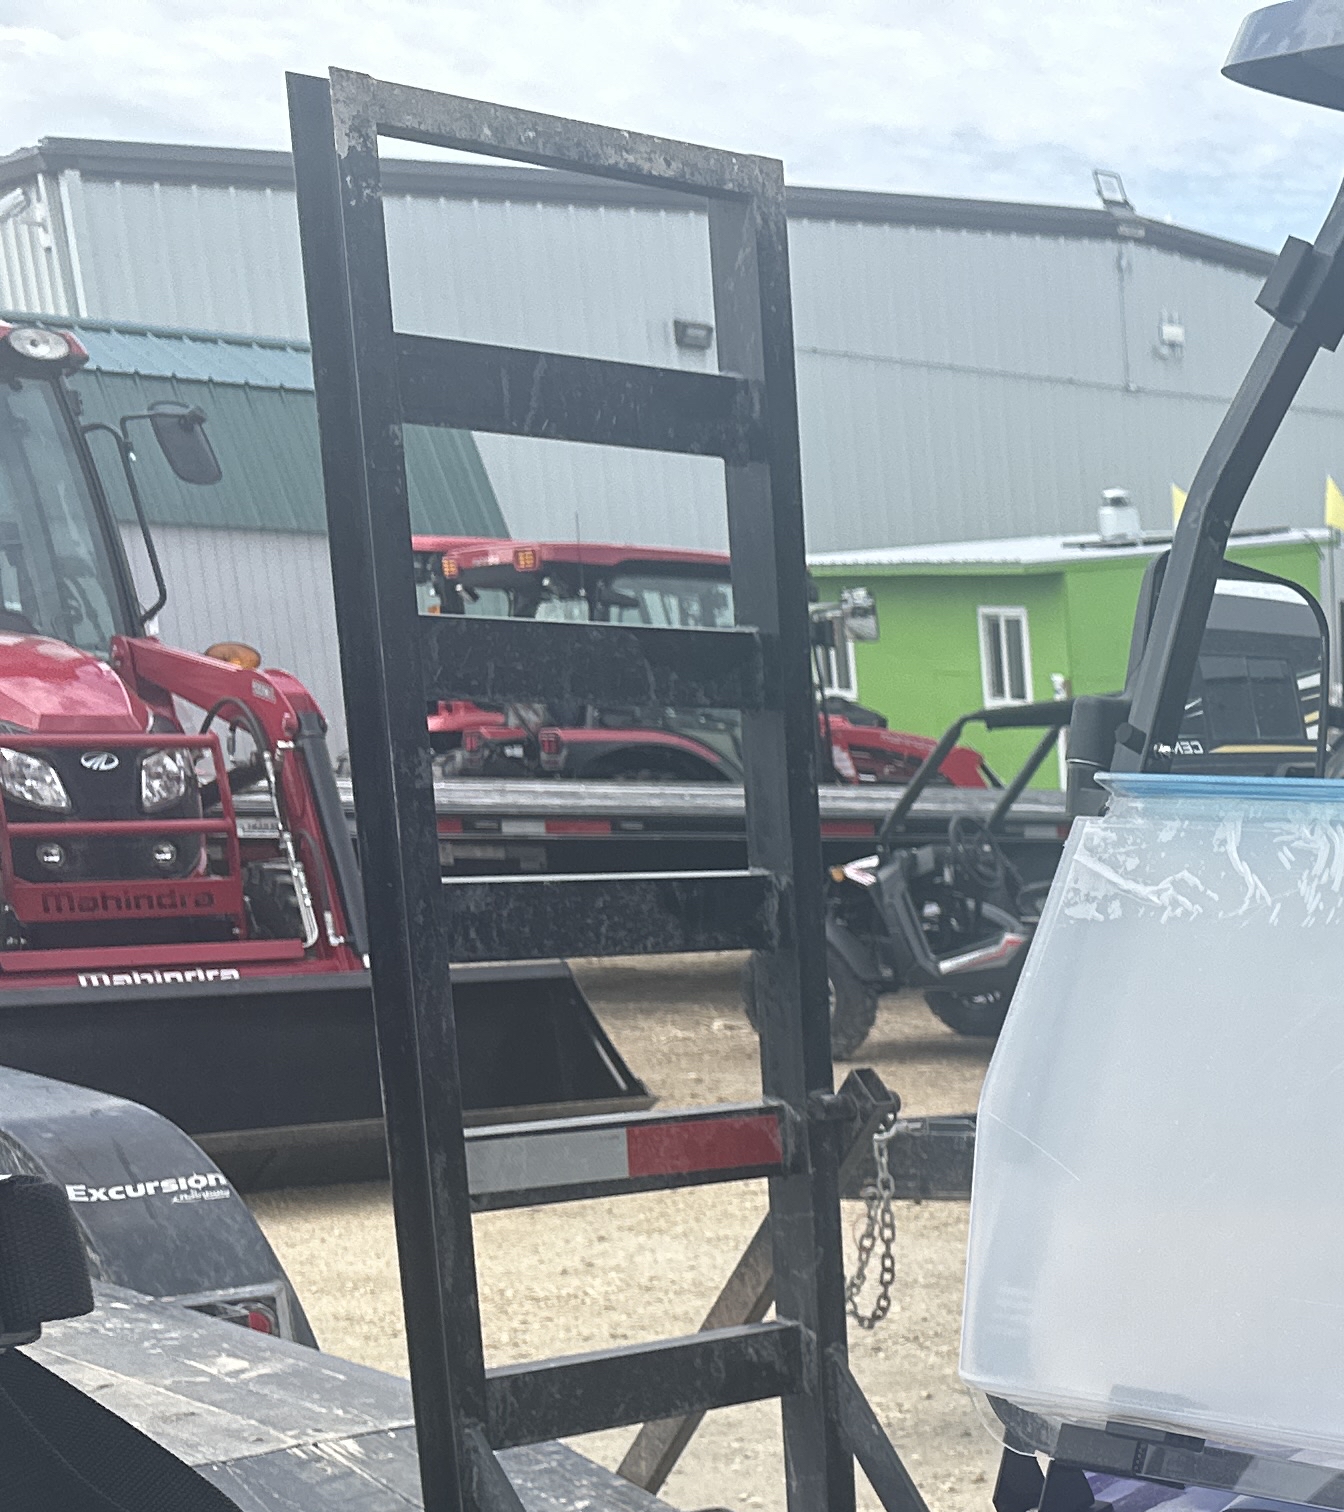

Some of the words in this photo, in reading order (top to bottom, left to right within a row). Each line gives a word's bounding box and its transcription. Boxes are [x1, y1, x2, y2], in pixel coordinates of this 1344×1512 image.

[41, 888, 214, 914] Mahindra
[77, 967, 240, 988] Mahindra
[65, 1172, 228, 1202] Excursion
